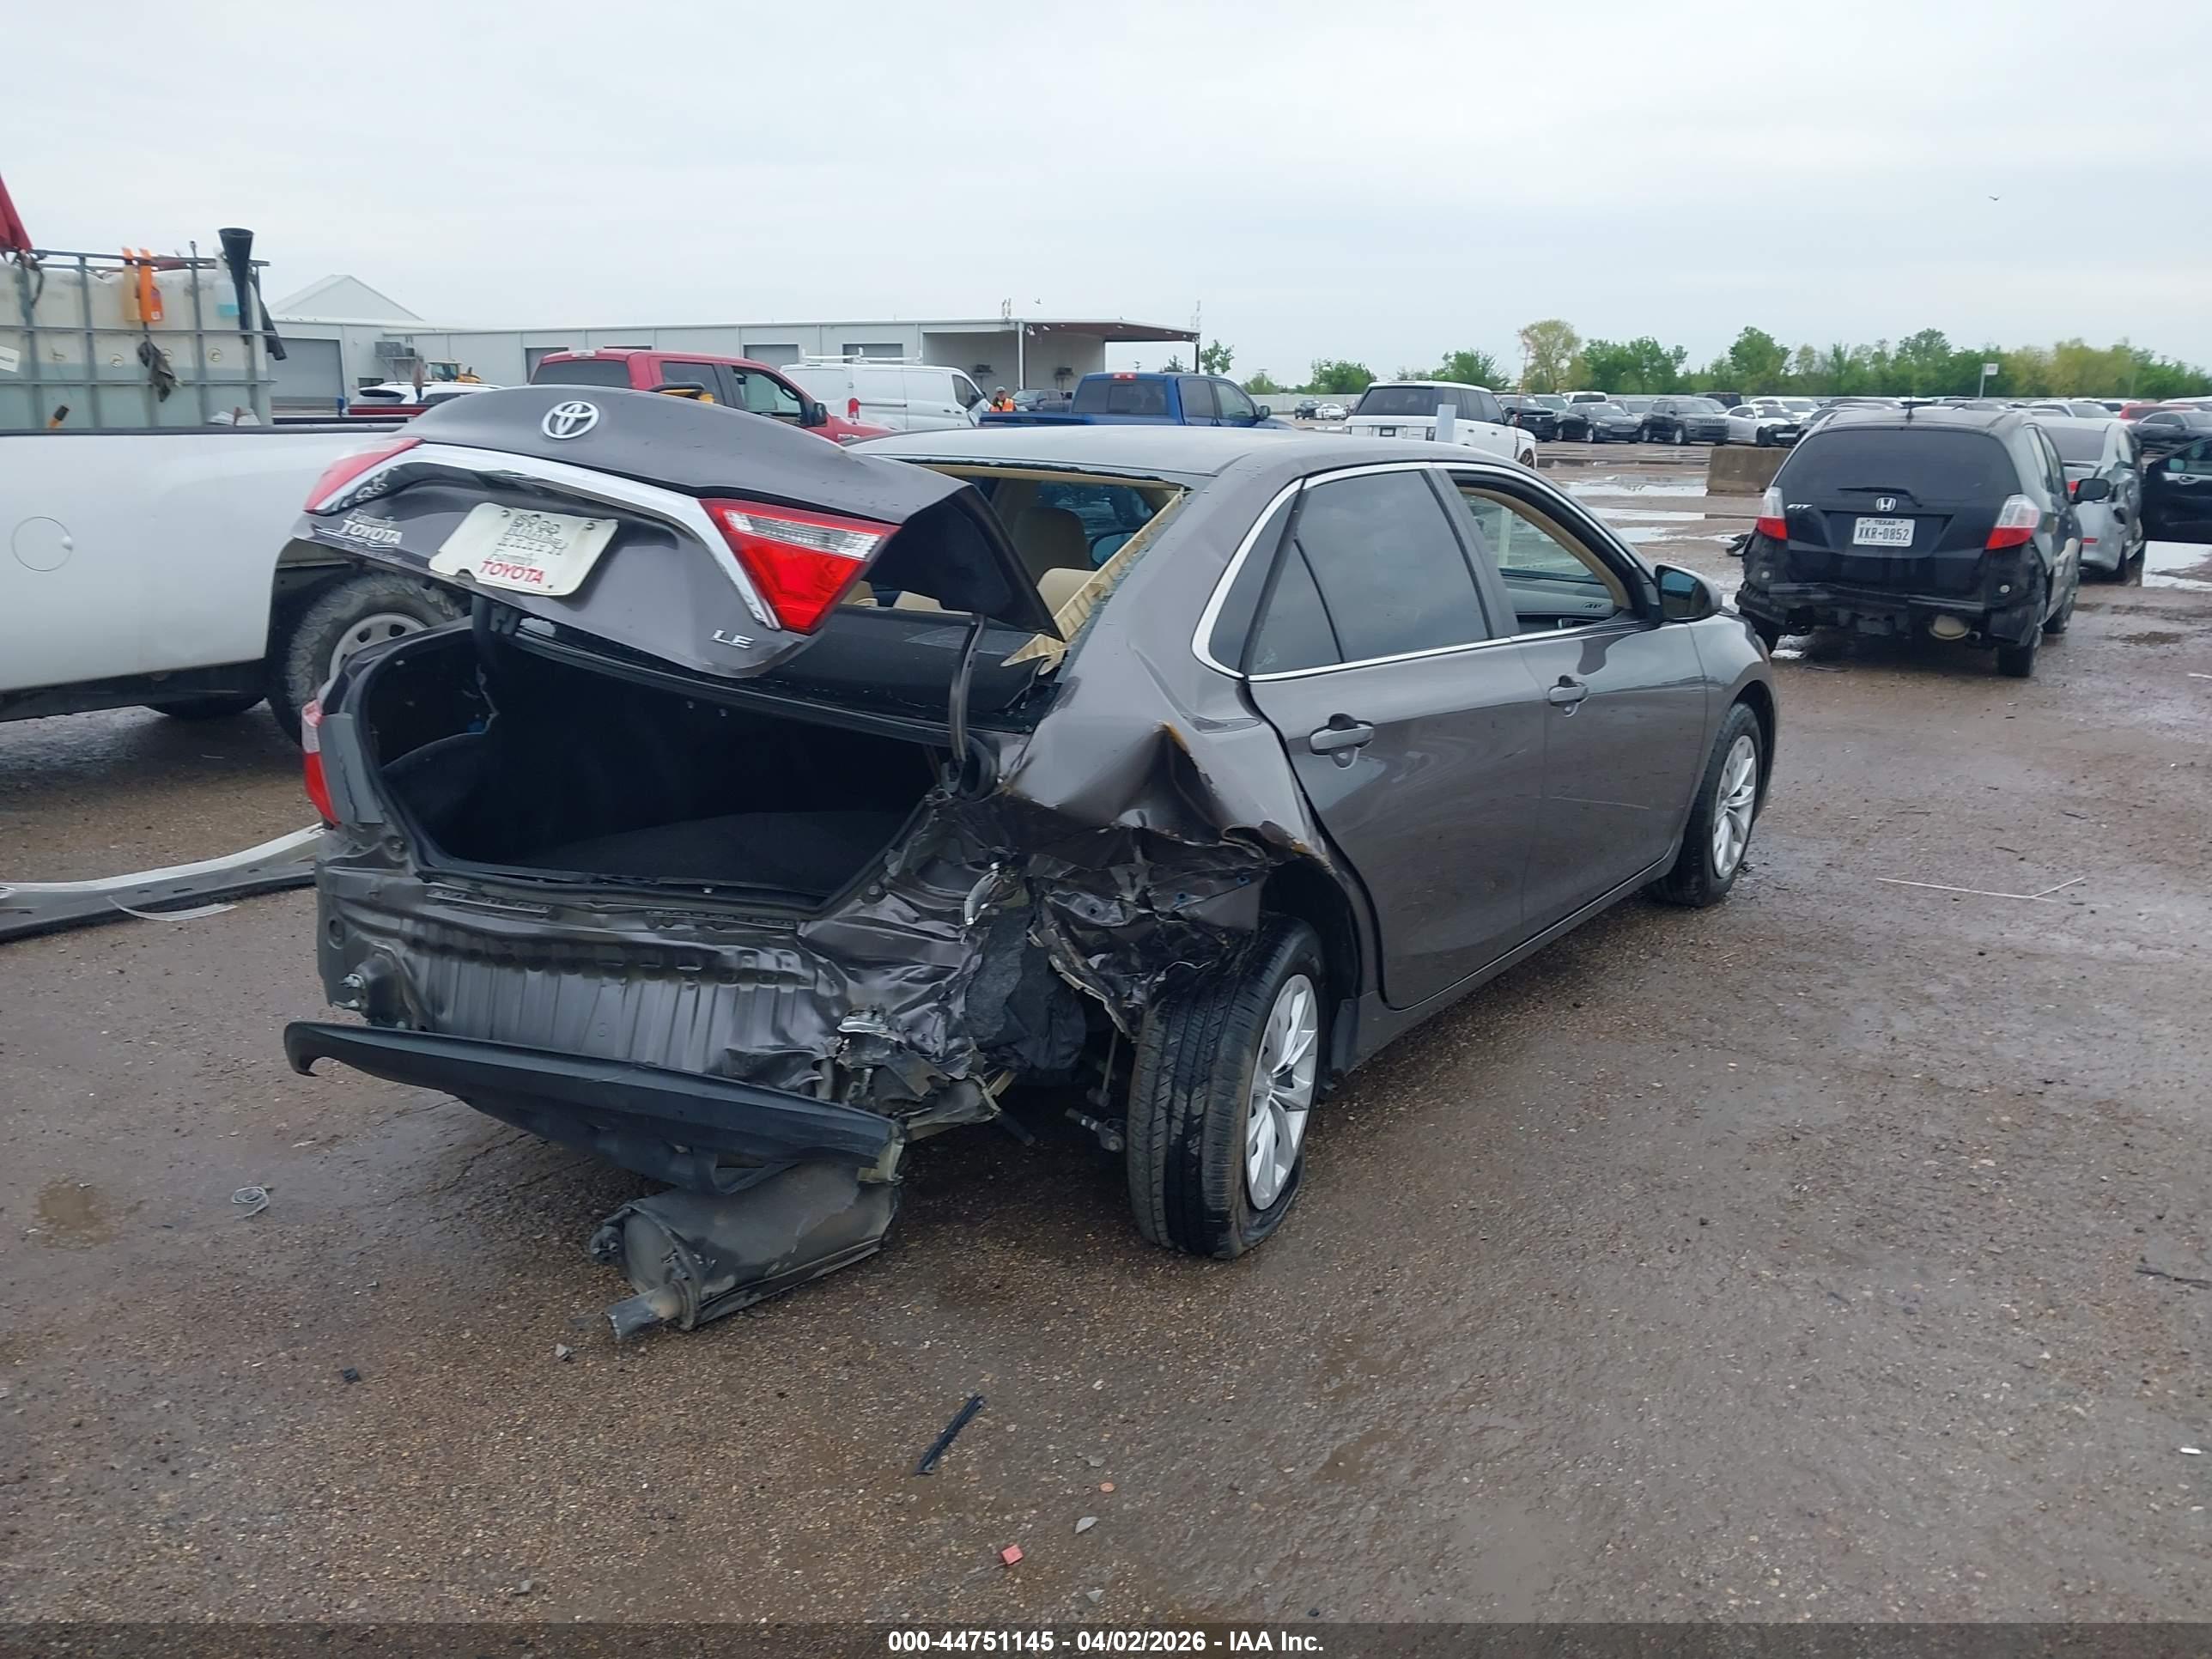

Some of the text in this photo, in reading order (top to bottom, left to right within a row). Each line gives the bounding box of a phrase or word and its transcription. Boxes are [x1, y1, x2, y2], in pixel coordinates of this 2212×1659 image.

[342, 519, 403, 544] TOYOTA
[1857, 526, 1910, 541] XKR-0852
[479, 560, 546, 584] TOYOTA
[709, 629, 756, 649] LE
